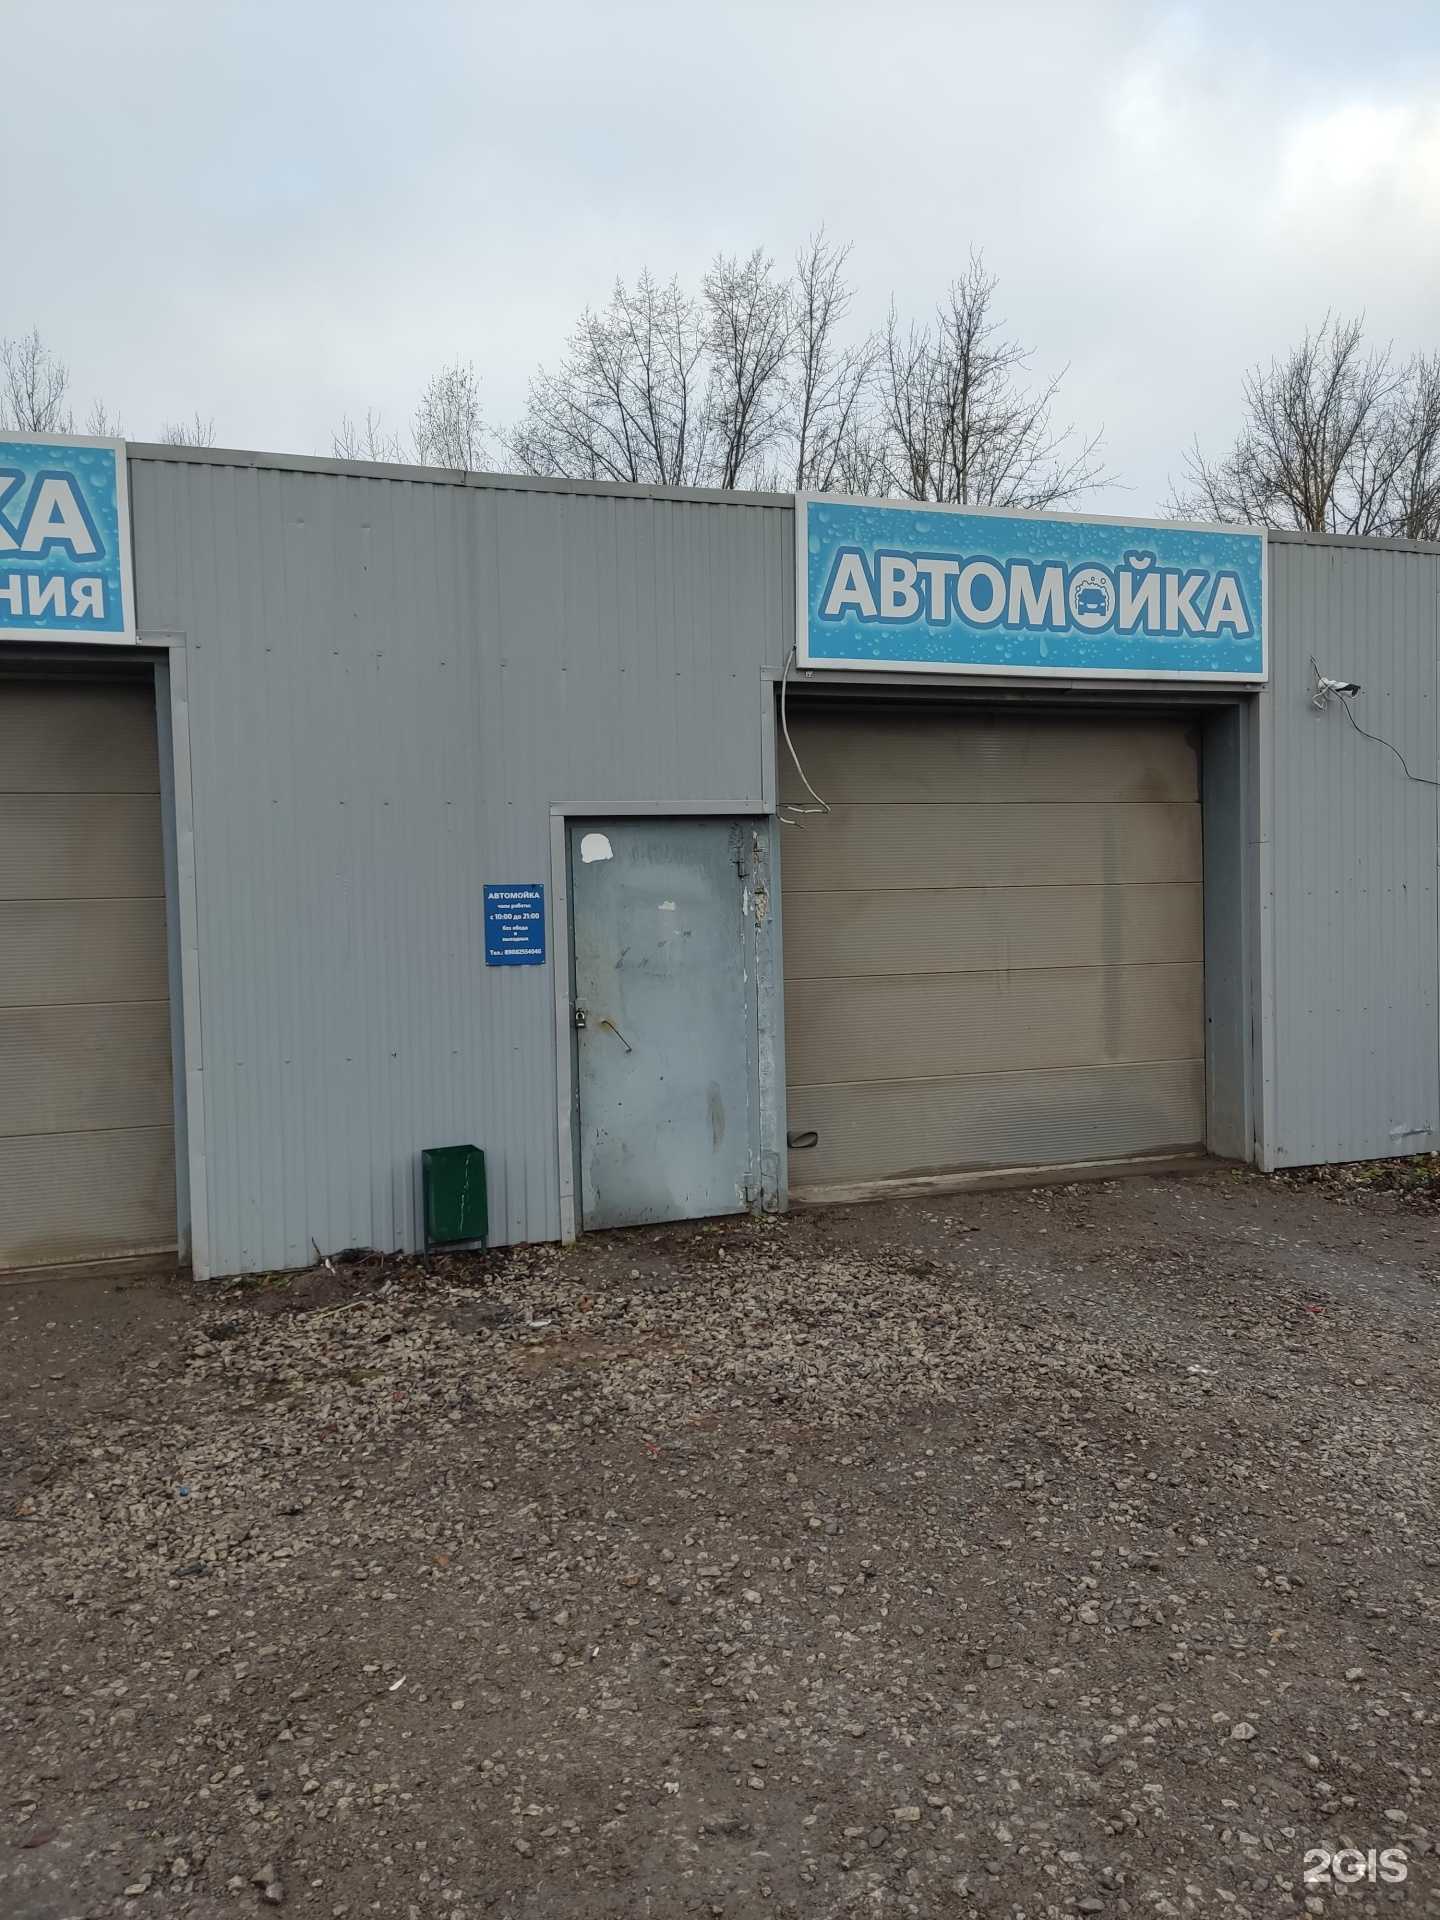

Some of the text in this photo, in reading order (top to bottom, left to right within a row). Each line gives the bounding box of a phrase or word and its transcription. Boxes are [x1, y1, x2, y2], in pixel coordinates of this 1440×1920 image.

[0, 476, 97, 555] А
[824, 552, 1249, 634] АВТОМОЙКА
[488, 891, 540, 900] АВТОМОЙКА
